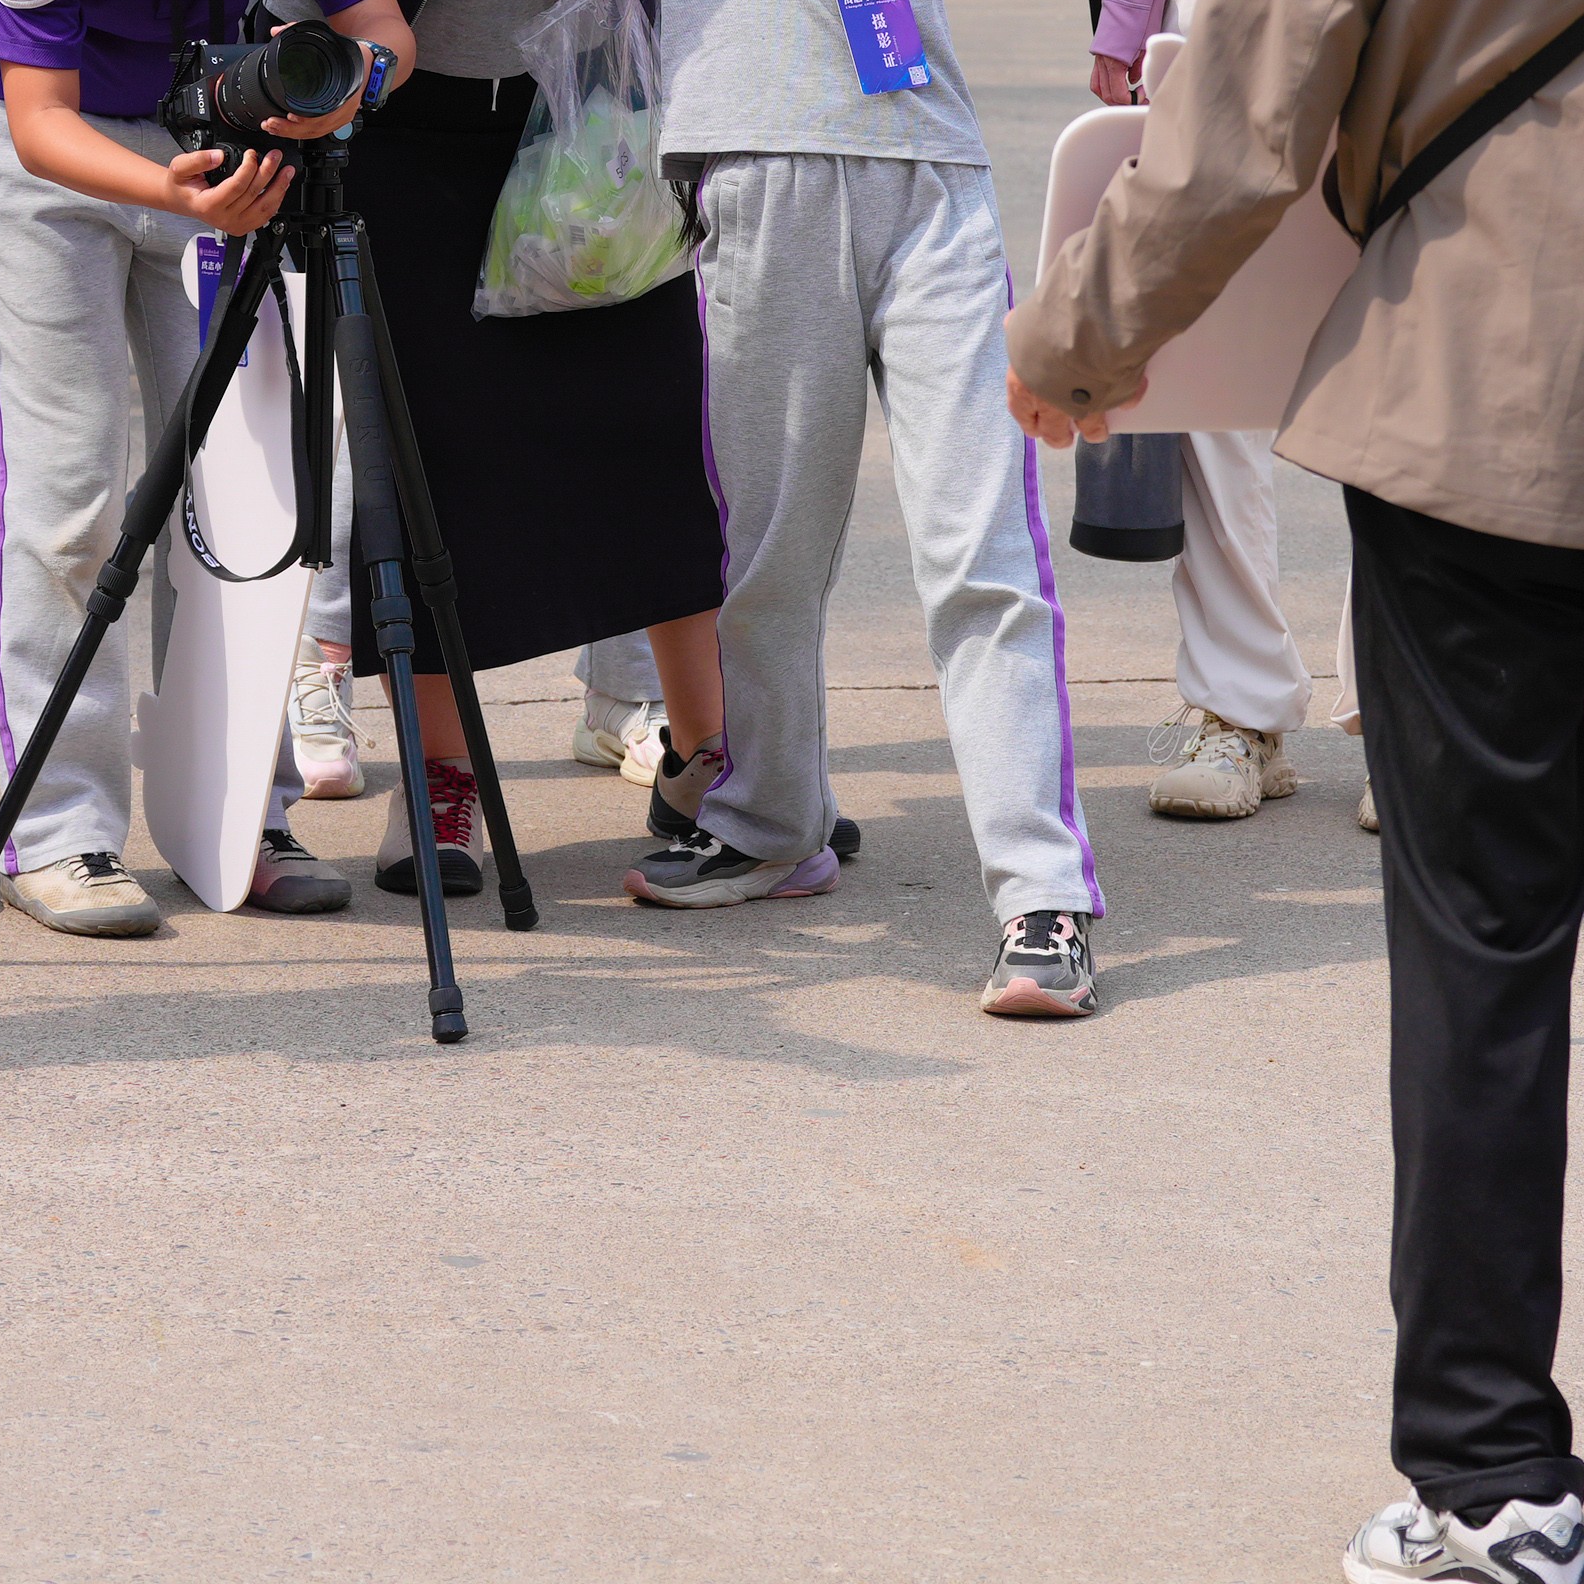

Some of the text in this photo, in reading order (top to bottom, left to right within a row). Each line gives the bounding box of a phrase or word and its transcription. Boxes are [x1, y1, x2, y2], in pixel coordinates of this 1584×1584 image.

[871, 12, 898, 68] 摄影证
[196, 87, 206, 115] SONY
[349, 357, 393, 515] SIRUI
[186, 487, 221, 568] SONY
